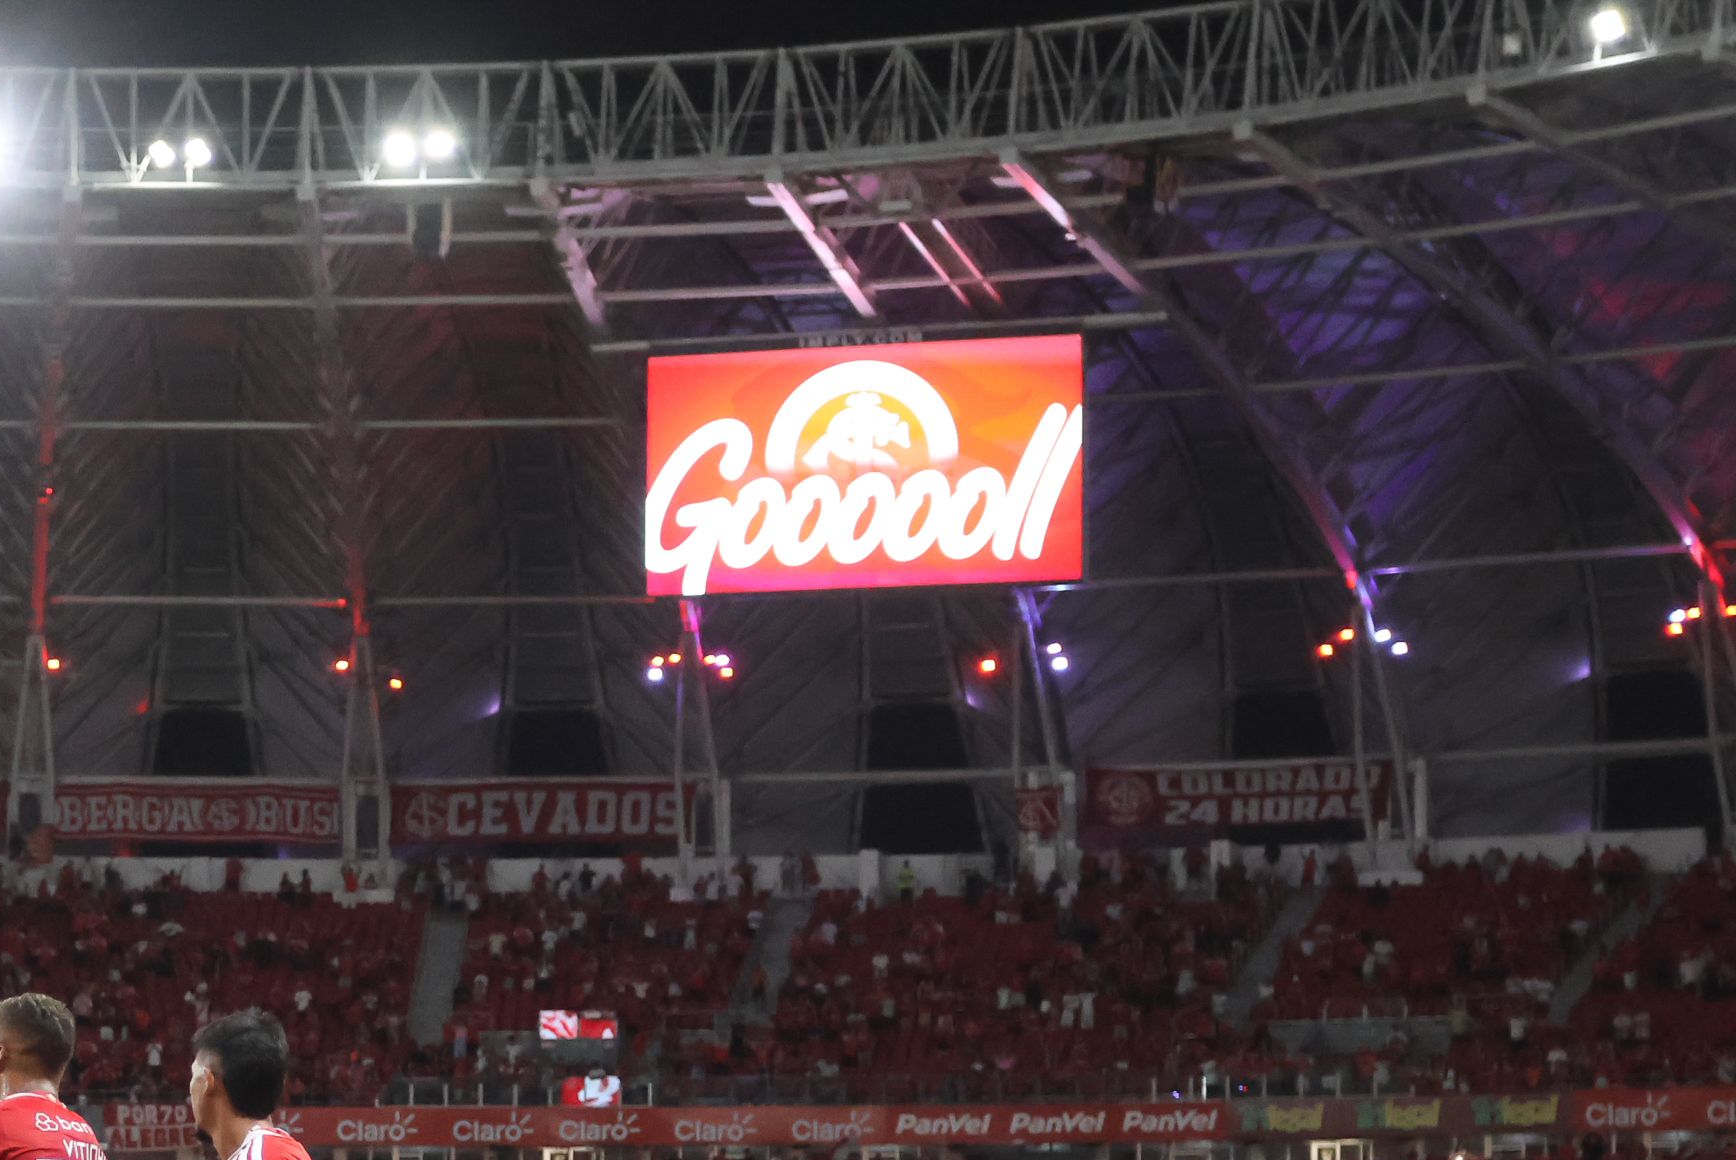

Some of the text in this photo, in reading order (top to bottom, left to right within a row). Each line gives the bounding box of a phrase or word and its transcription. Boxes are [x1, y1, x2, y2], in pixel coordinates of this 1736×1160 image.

[1157, 766, 1382, 797] COLORADO
[445, 790, 680, 837] CEVADOS
[1165, 796, 1366, 826] 24 HORAS
[896, 1113, 992, 1135] PanVel
[1010, 1110, 1106, 1135] PanVel
[1123, 1108, 1219, 1134] PanVel
[1585, 1102, 1658, 1127] Claro
[336, 1119, 405, 1142] Claro
[452, 1119, 523, 1142] Claro
[559, 1119, 629, 1142] Claro
[675, 1118, 745, 1142] Claro
